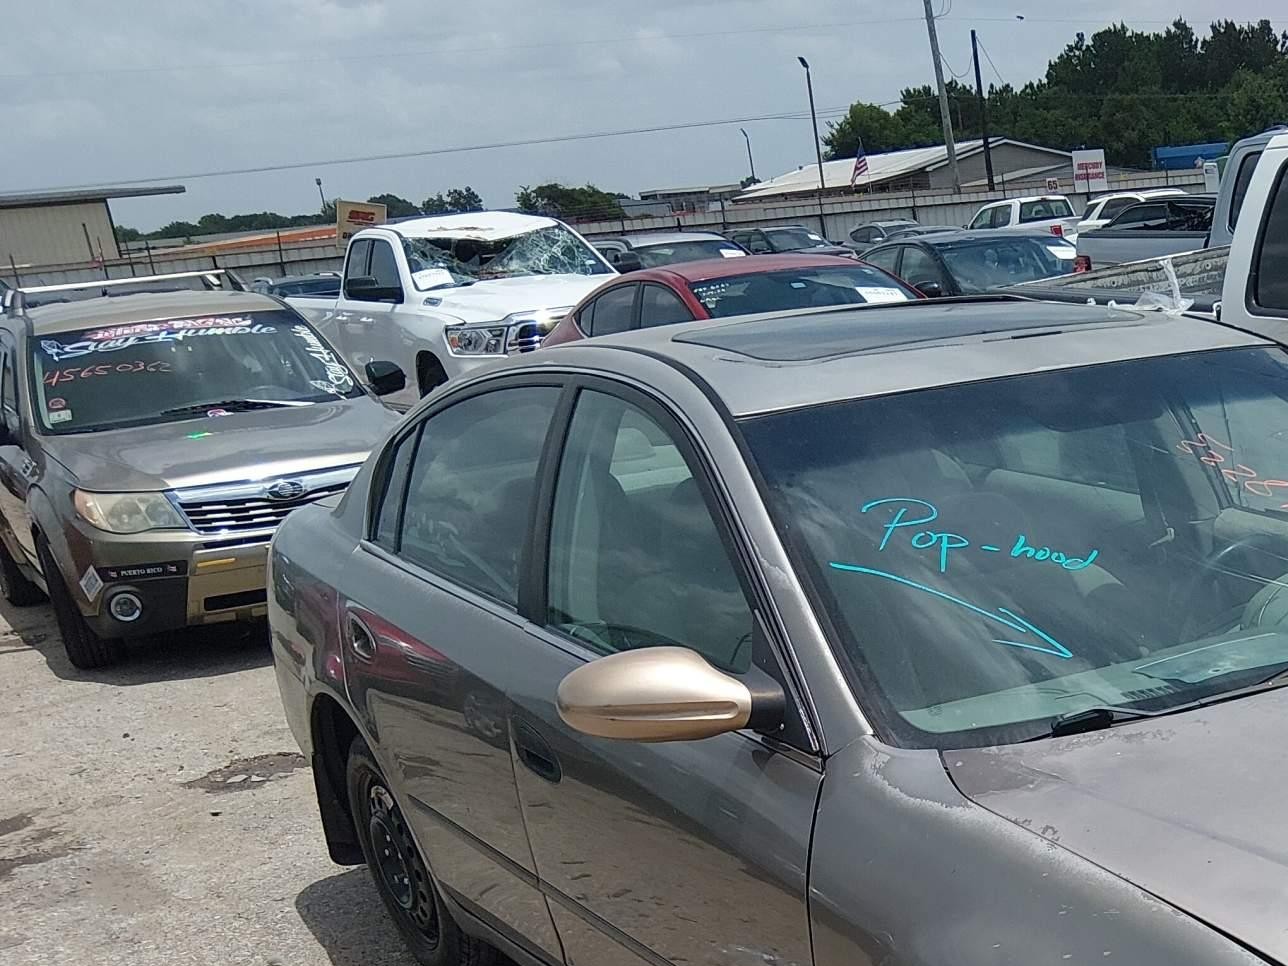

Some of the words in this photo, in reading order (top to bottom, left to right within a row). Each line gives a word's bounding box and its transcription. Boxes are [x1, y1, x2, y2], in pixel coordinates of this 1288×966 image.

[1048, 181, 1058, 190] 65
[42, 360, 173, 386] 45650362
[120, 568, 146, 577] PUERTO
[147, 566, 163, 575] RICO
